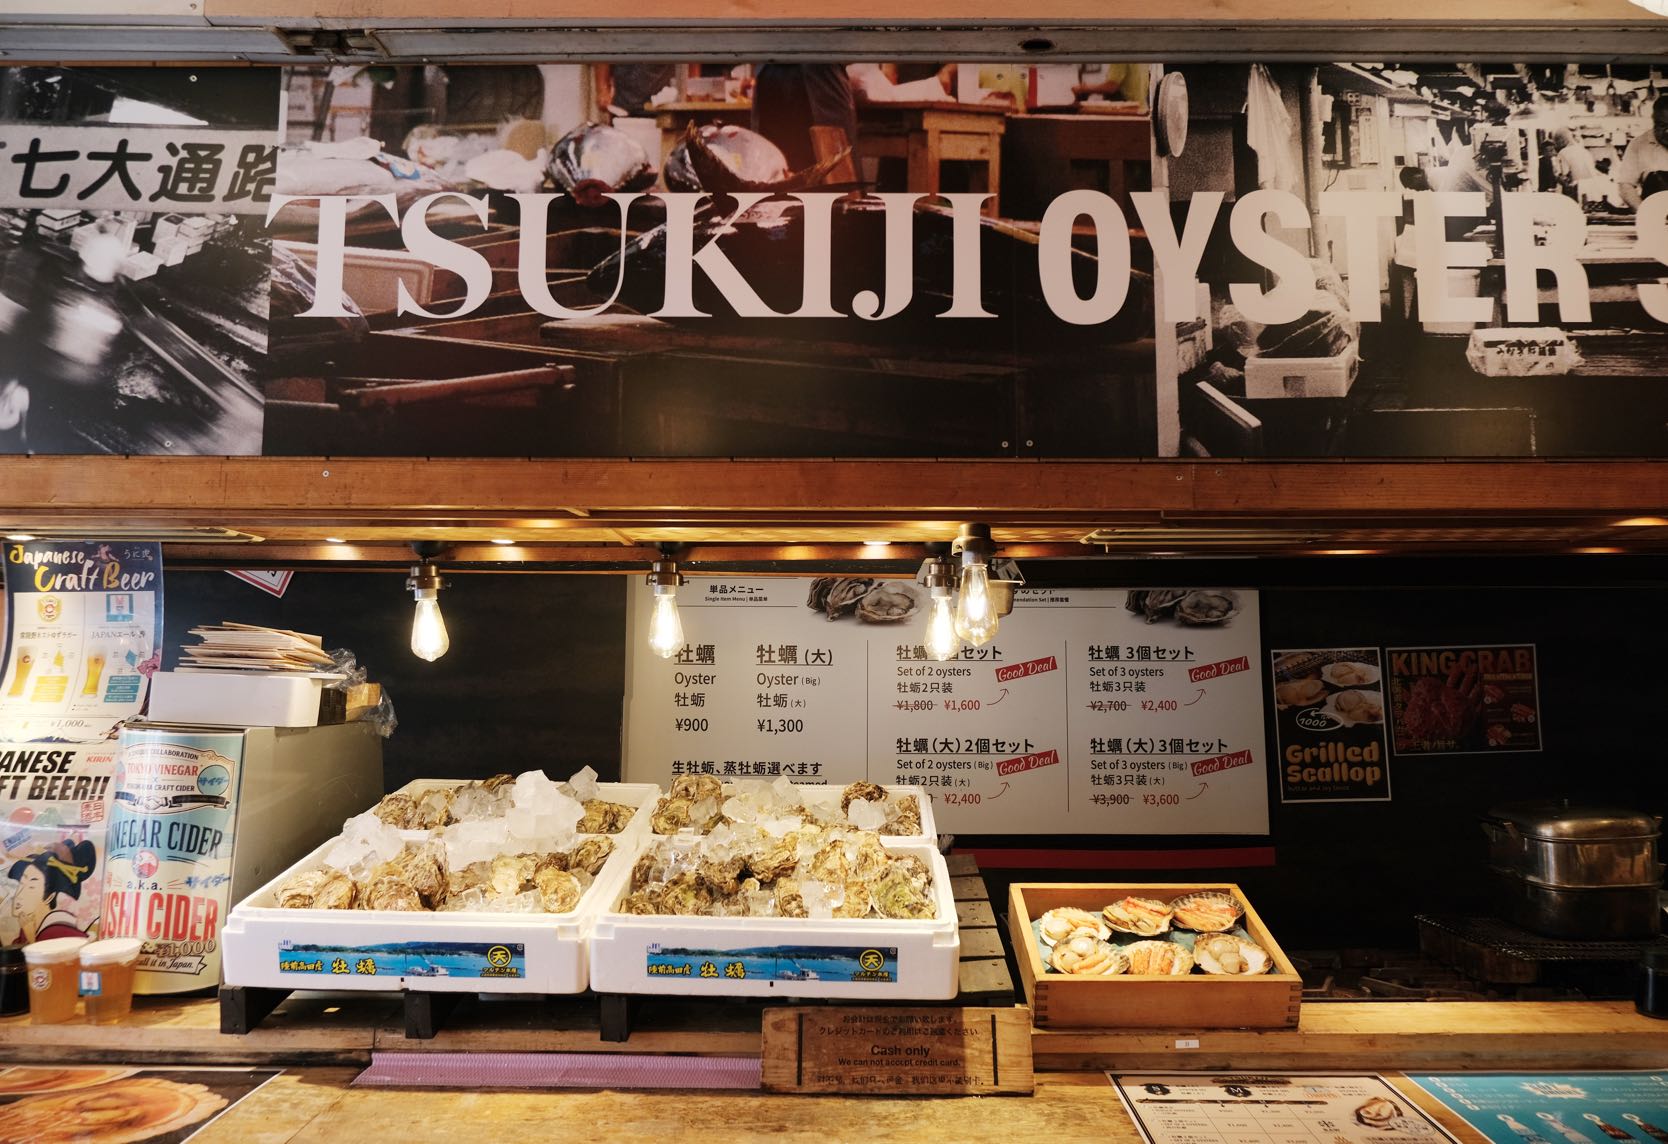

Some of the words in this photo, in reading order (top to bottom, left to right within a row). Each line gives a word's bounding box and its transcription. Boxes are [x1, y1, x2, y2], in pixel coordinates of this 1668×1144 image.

[0, 137, 276, 202] 七大通路
[264, 191, 999, 321] TSUKIJI
[1037, 189, 1592, 326] OYSTER
[9, 544, 85, 569] Japanese
[34, 560, 99, 592] Craft
[103, 561, 155, 591] Beer
[709, 584, 764, 594] 単品メニュー
[997, 666, 1026, 682] Good
[1027, 657, 1055, 675] Deal
[1190, 666, 1219, 682] Good
[1219, 657, 1247, 675] Deal
[1391, 651, 1456, 675] KING
[1457, 649, 1532, 674] CRAB
[674, 672, 716, 687] Oyster
[897, 667, 913, 676] Set
[915, 666, 926, 676] of
[927, 667, 934, 676] 2
[935, 667, 972, 679] oysters
[1089, 667, 1106, 676] Set
[1107, 666, 1119, 676] of
[1120, 667, 1126, 676] 3
[1128, 667, 1164, 678] oysters
[756, 673, 799, 688] Oyster
[674, 692, 705, 707] 牡蛎
[896, 700, 934, 713] ¥1,800
[944, 700, 981, 713] ¥1,600
[1090, 700, 1127, 713] ¥2,700
[1141, 700, 1178, 713] ¥2,400
[675, 718, 709, 732] ¥900
[757, 719, 804, 735] ¥1,300
[1299, 718, 1328, 728] 1000
[1285, 741, 1380, 764] Grilled
[0, 751, 76, 774] ANESE
[154, 763, 198, 777] VINEGAR
[896, 760, 913, 769] Set
[915, 759, 926, 769] of
[927, 760, 934, 769] 2
[936, 760, 972, 772] oysters
[998, 760, 1026, 776] Good
[1028, 751, 1056, 769] Deal
[1091, 760, 1107, 769] Set
[1109, 760, 1120, 769] of
[1121, 760, 1127, 769] 3
[1130, 761, 1166, 772] oysters
[1192, 760, 1221, 776] Good
[1221, 751, 1249, 770] Deal
[1286, 762, 1382, 786] Scallop
[27, 775, 111, 801] BEER!!
[176, 784, 195, 792] CIDER
[944, 794, 981, 806] ¥2,400
[1092, 794, 1130, 807] ¥3,900
[1143, 794, 1180, 807] ¥3,600
[109, 819, 162, 852] INEGAR
[168, 821, 223, 860] CIDER
[127, 880, 162, 890] a.k.a.
[146, 892, 218, 942] CIDER
[871, 1045, 901, 1056] Cash
[905, 1045, 930, 1057] only
[838, 1058, 851, 1066] We
[870, 1058, 883, 1066] not
[885, 1058, 913, 1067] accept
[915, 1058, 938, 1066] credit
[940, 1058, 961, 1066] card.
